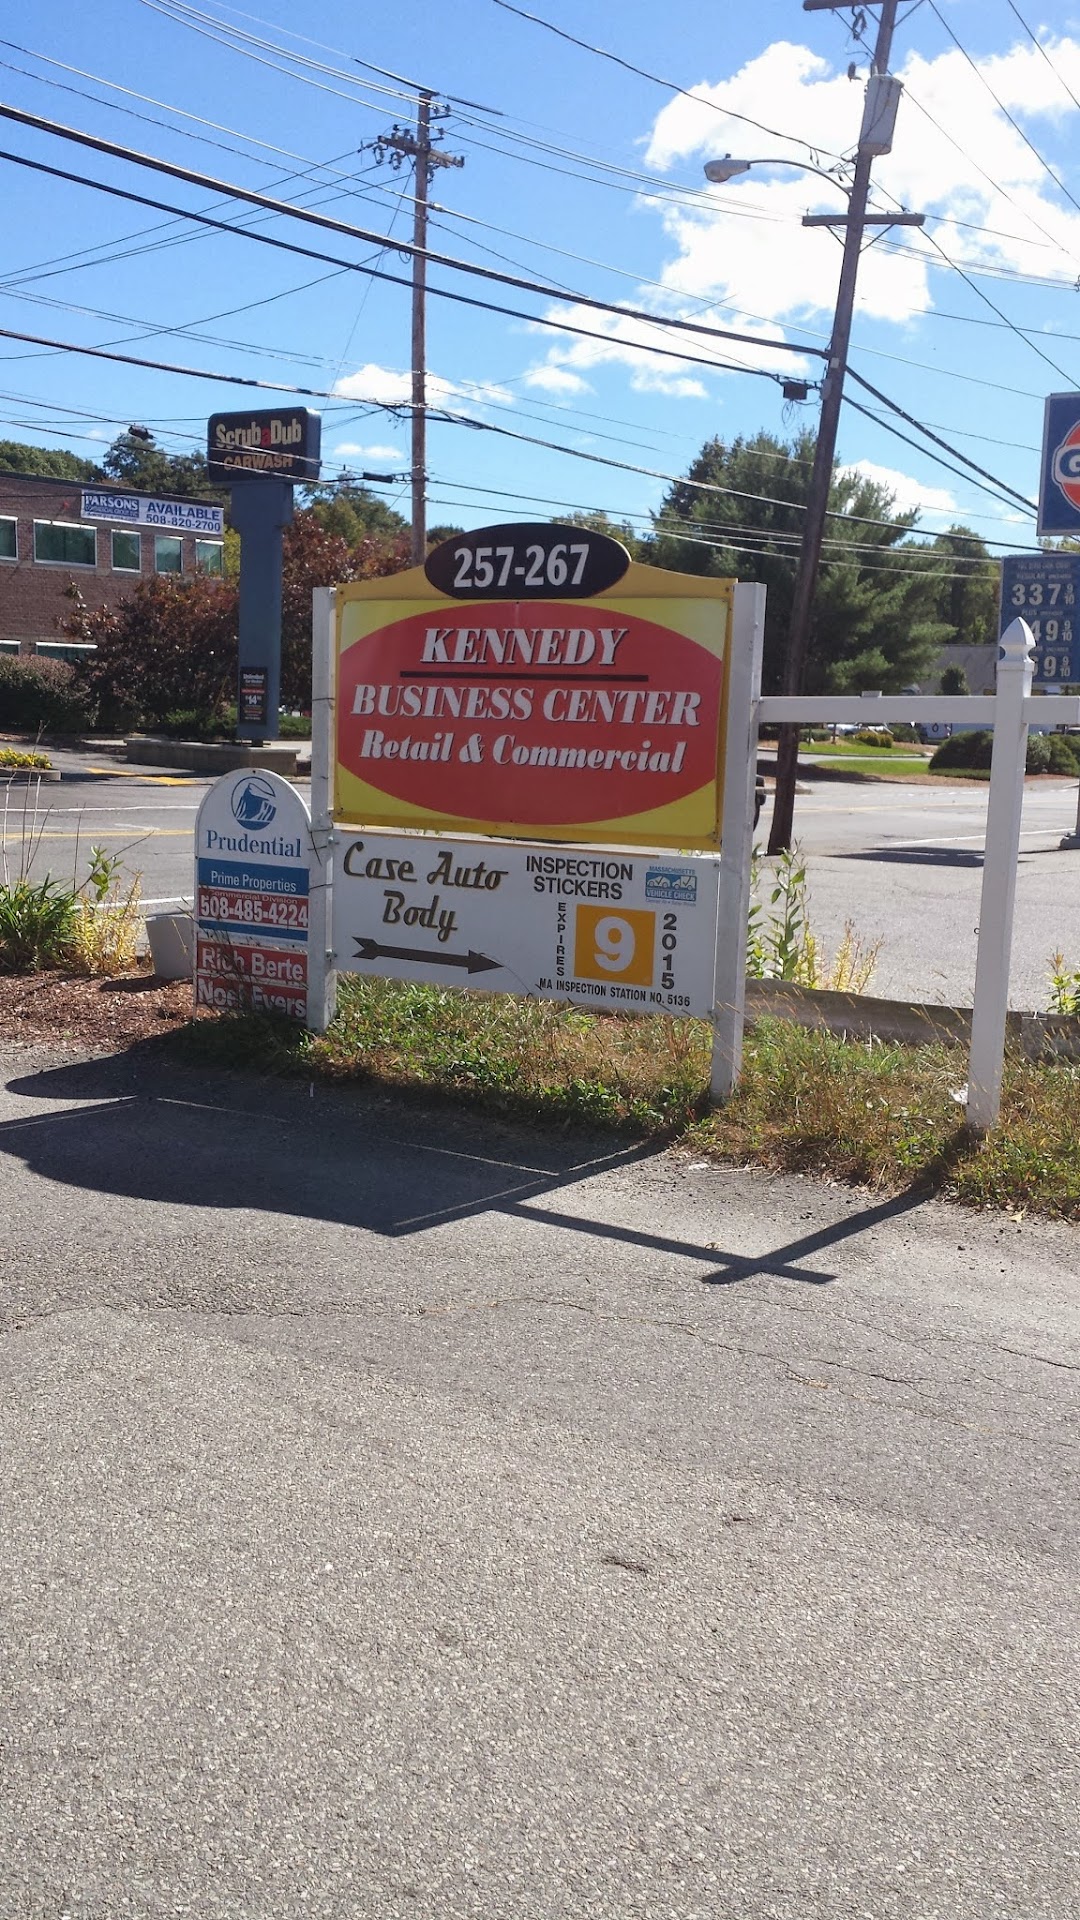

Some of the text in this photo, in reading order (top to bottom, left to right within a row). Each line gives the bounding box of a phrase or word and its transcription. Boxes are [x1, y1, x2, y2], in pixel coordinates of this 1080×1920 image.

[85, 495, 138, 511] PARSONS
[147, 502, 220, 521] AVAILABLE
[146, 513, 221, 532] 508-820-2700
[453, 543, 590, 588] 257-267
[420, 627, 628, 666] KENNEDY
[350, 684, 701, 727] BUSINESS CENTER
[359, 729, 688, 774] Retail & Commercial
[206, 829, 302, 858] Prudential
[343, 841, 509, 890] Case Auto
[526, 855, 634, 881] INSPECTION
[649, 865, 696, 875] MASSACHUSETTS
[207, 889, 298, 905] Commercial Division
[211, 870, 297, 893] Prime Properties
[533, 876, 623, 900] STICKERS
[647, 888, 695, 901] VEHICLE CHECK
[200, 894, 309, 927] 508-485-4224
[382, 889, 458, 942] Body
[556, 902, 567, 977] EXPIRES
[593, 916, 636, 973] 9
[661, 913, 678, 990] 2015
[202, 947, 304, 981] Rich Berte
[539, 977, 691, 1007] MA INSPECTION STATION NO. 5136
